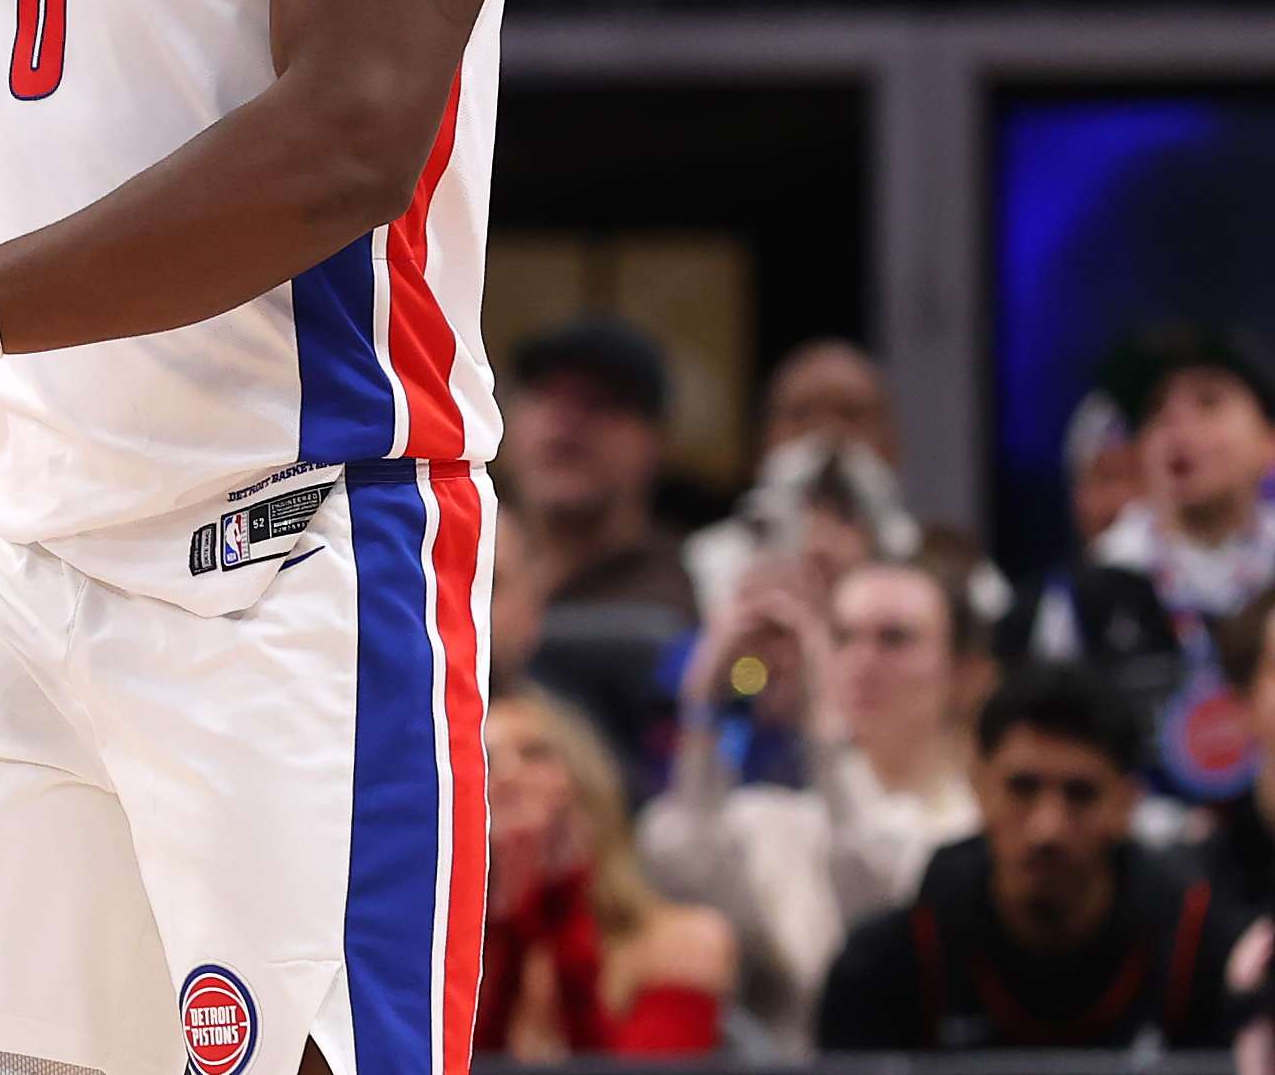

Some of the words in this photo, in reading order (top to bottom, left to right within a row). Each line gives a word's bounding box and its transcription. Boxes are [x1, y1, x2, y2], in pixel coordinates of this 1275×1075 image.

[227, 477, 271, 502] DETROIT
[252, 517, 265, 530] 52
[189, 1005, 237, 1026] DETROIT
[191, 1025, 239, 1047] PISTONS
